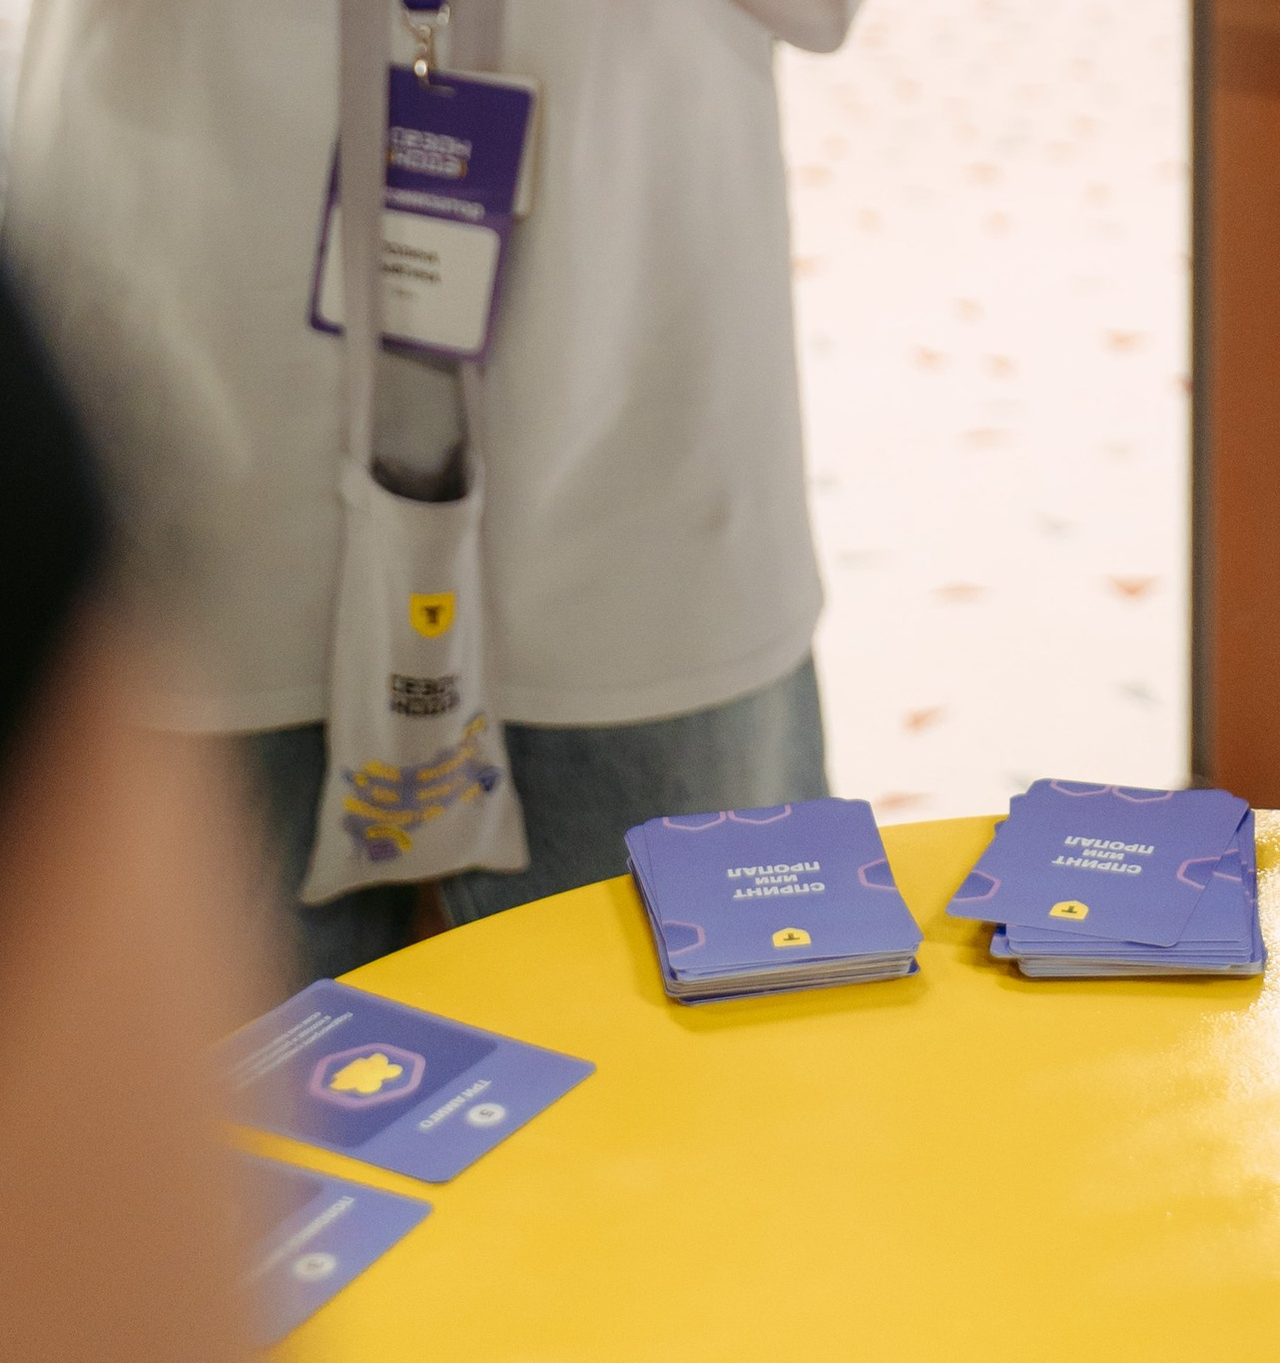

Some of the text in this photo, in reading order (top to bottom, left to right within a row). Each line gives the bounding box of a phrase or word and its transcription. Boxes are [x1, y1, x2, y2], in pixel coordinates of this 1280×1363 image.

[1064, 835, 1154, 854] ПРОПАЛ
[1082, 848, 1125, 860] ИЛИ
[727, 861, 820, 877] ПРОПАЛ
[1051, 855, 1142, 873] СПРИНТ
[755, 874, 798, 885] ИЛИ
[733, 882, 825, 898] СПРИНТ
